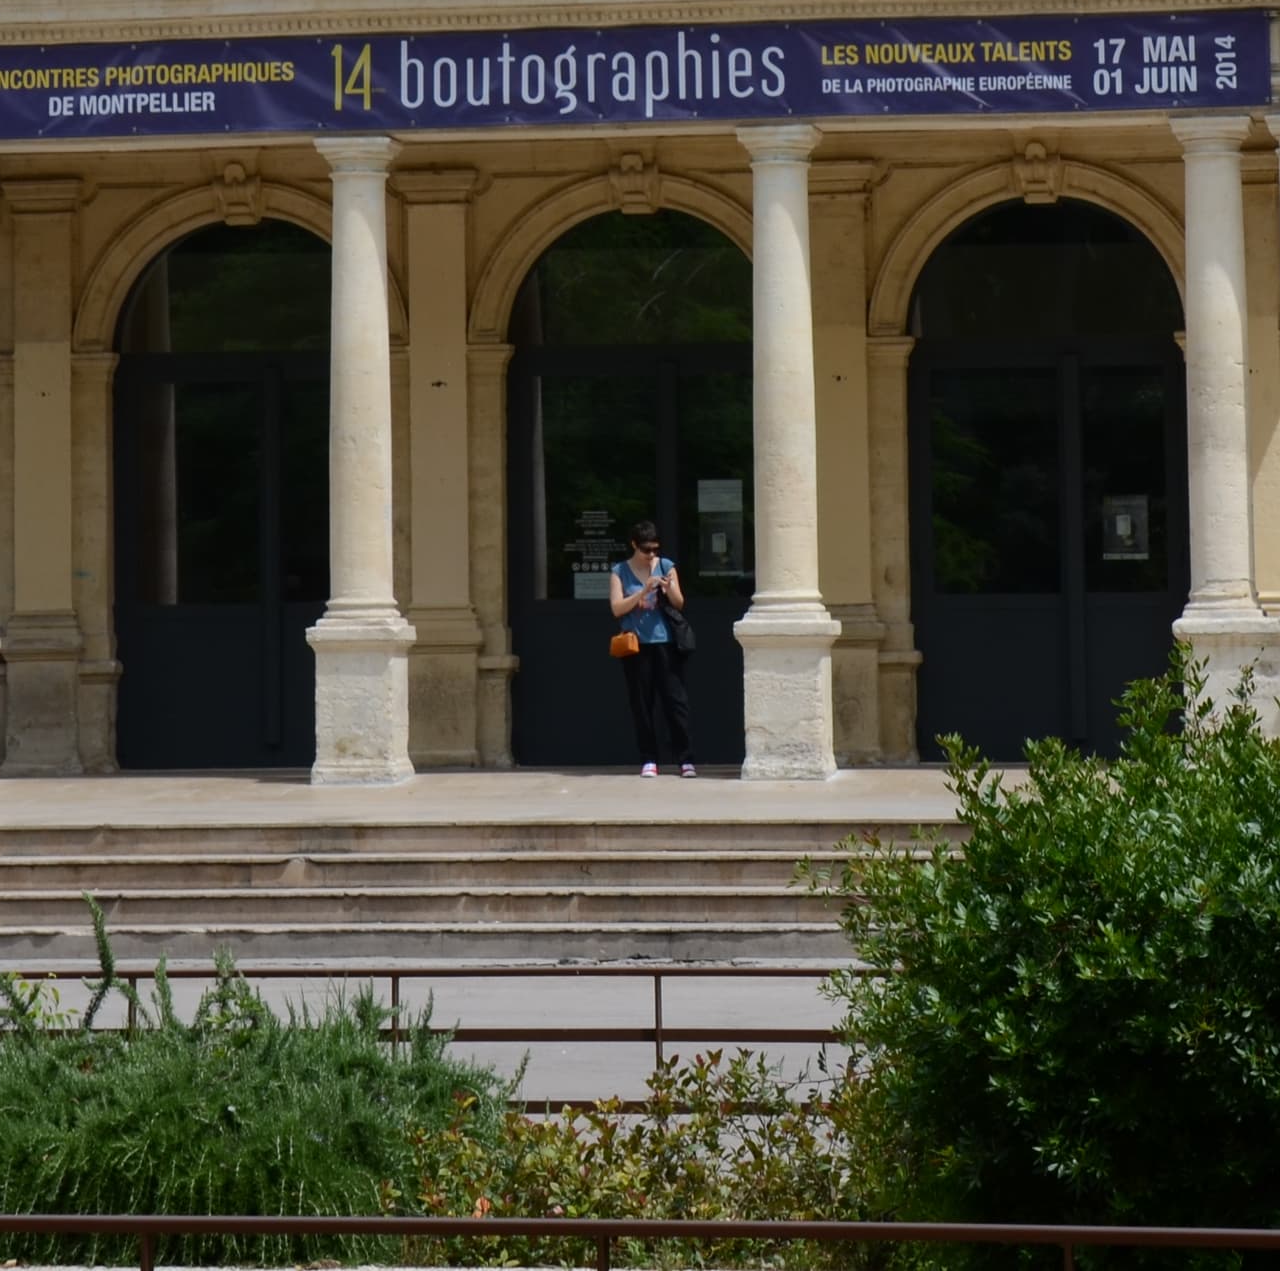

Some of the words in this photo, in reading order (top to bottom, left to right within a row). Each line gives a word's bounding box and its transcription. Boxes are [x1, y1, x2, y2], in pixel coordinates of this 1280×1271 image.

[821, 45, 859, 65] LES
[865, 42, 975, 64] NOUVEAUX
[980, 40, 1073, 62] TALENTS
[1093, 38, 1126, 65] 17
[1142, 35, 1196, 63] MAI
[1215, 35, 1237, 90] 2014
[105, 61, 295, 87] PHOTOGRAPHIQUES
[331, 43, 375, 111] 14
[400, 31, 786, 119] boutographies
[822, 78, 841, 94] DE
[844, 78, 863, 94] LA
[867, 75, 975, 93] PHOTOGRAPHIE
[979, 71, 1072, 92] EUROPÉENNE
[1093, 68, 1123, 96] 01
[1134, 66, 1198, 94] JUIN
[48, 96, 74, 117] DE
[79, 91, 216, 116] MONTPELLIER
